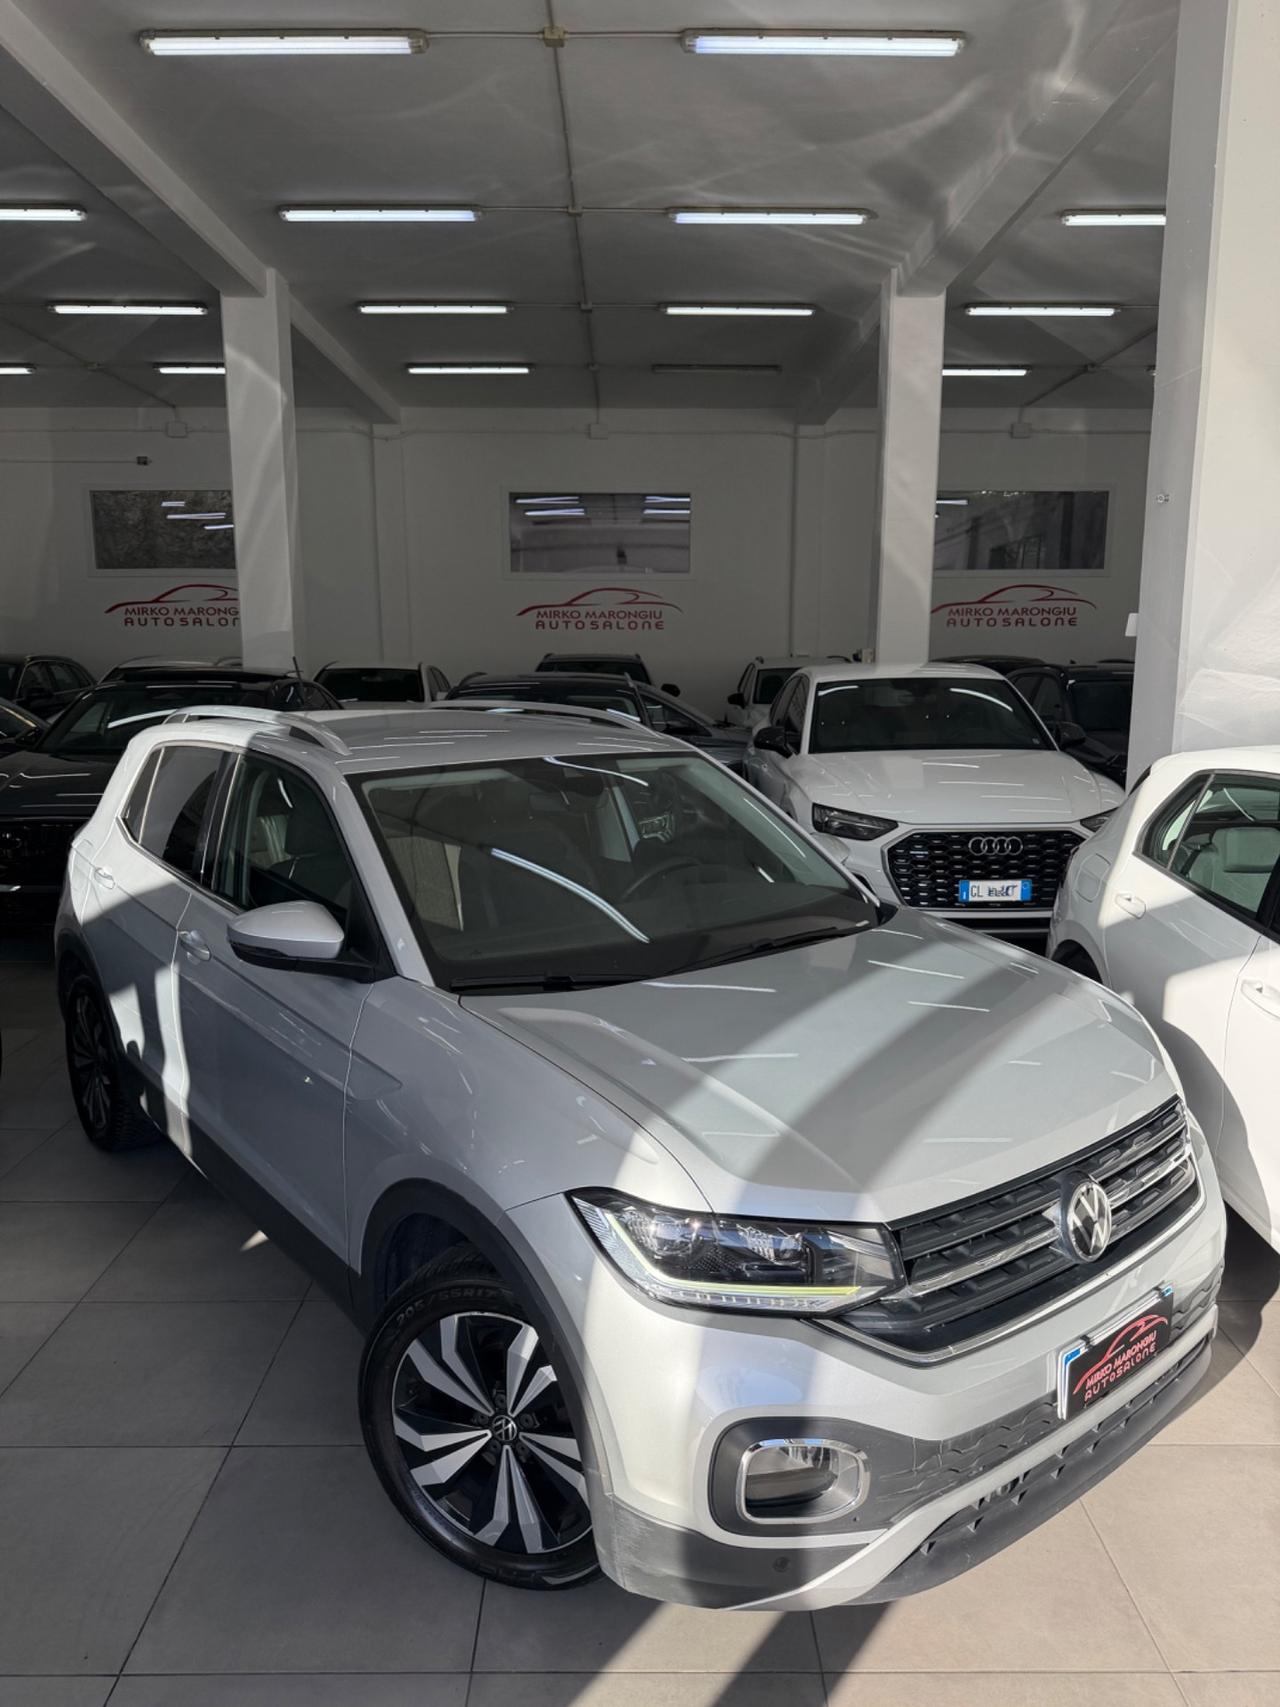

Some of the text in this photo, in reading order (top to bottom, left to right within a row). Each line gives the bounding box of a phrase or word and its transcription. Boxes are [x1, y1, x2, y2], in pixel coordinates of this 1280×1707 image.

[124, 606, 239, 616] MIRKO MARONG
[536, 610, 663, 620] MIRKO MARONGIU
[948, 606, 1077, 617] MIRKO MARONGIU
[535, 620, 665, 630] AUTOSALONE
[946, 617, 1078, 628] AUTOSALONE
[1084, 1341, 1156, 1401] AUTOSALONE
